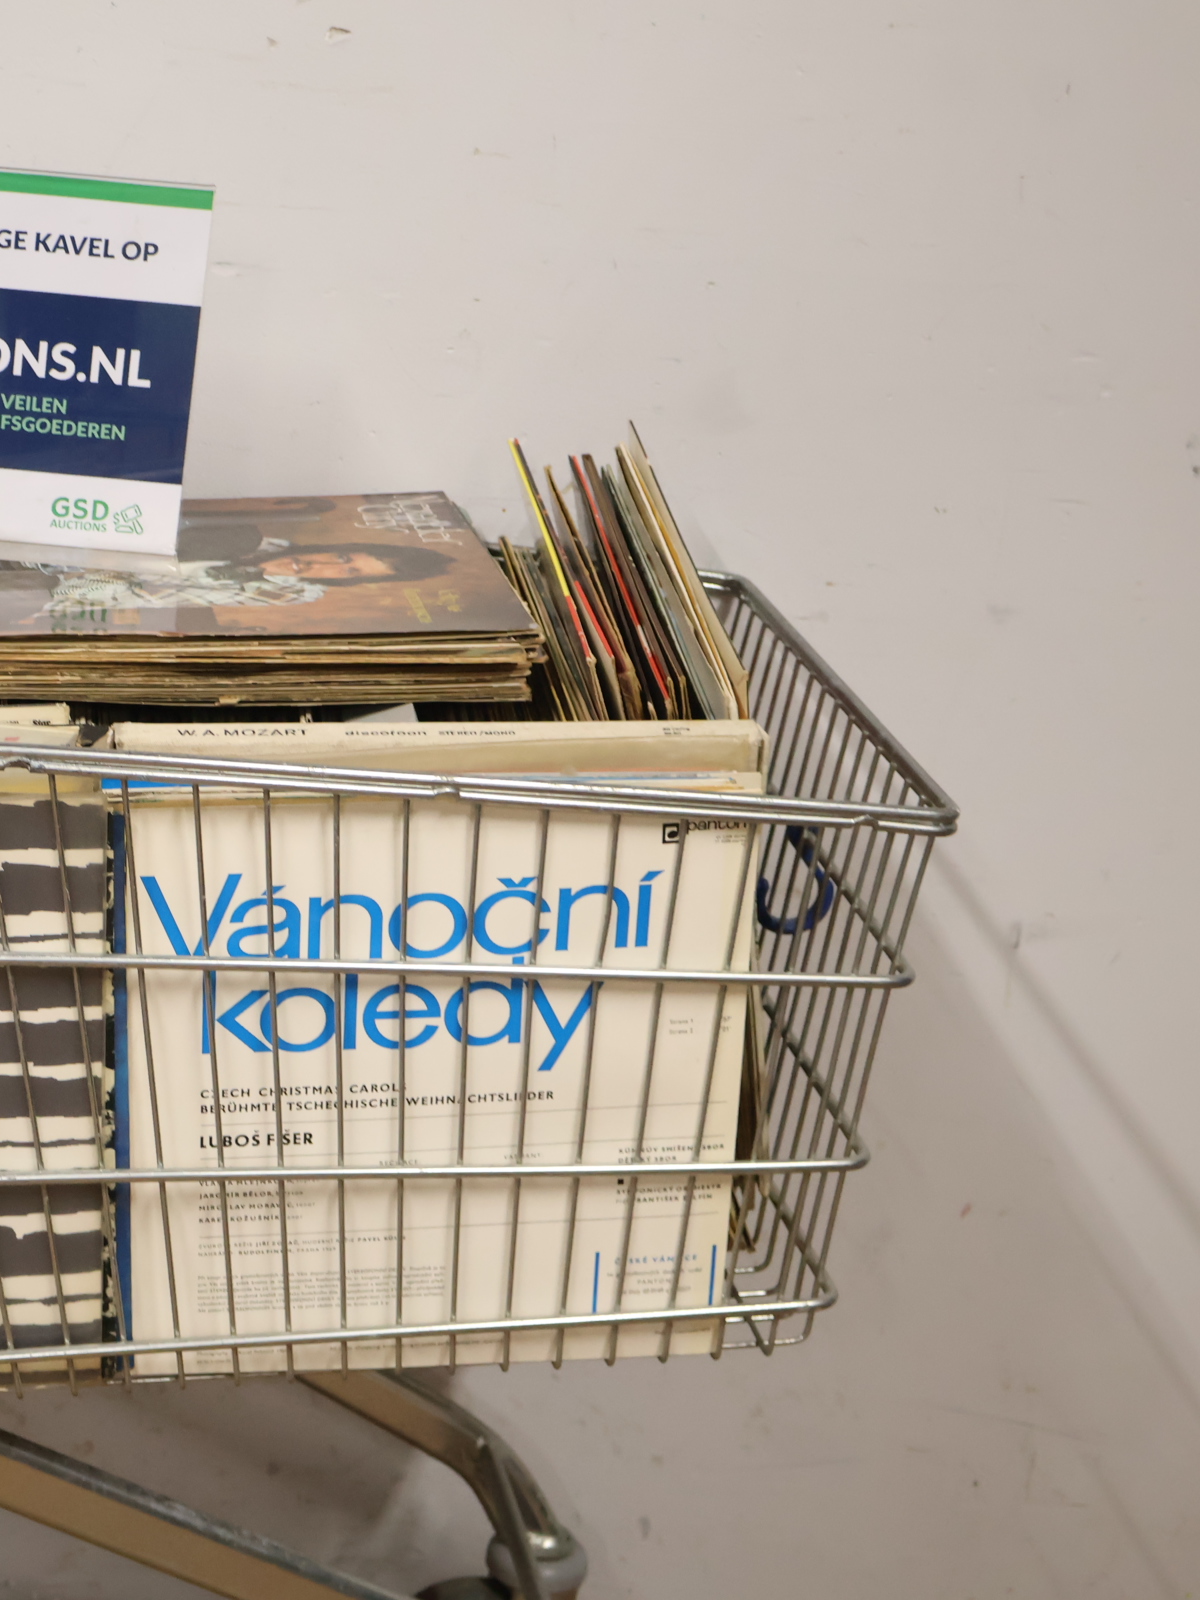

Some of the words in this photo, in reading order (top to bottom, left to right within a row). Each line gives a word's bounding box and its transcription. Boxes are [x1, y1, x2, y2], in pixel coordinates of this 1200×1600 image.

[34, 232, 115, 259] KAVEL
[121, 241, 159, 262] OP
[1, 393, 67, 415] VEILEN
[51, 497, 109, 521] GSD
[50, 518, 108, 533] AUCTIONS
[224, 728, 308, 737] MOZART
[140, 869, 665, 960] Vánoční
[201, 955, 604, 1072] koledy
[200, 1087, 250, 1099] CECH
[349, 1082, 407, 1094] CAROL
[406, 1090, 555, 1107] WEIHNCHTSLIDER
[200, 1129, 260, 1148] LUBOŠ
[267, 1128, 314, 1146] FŠER
